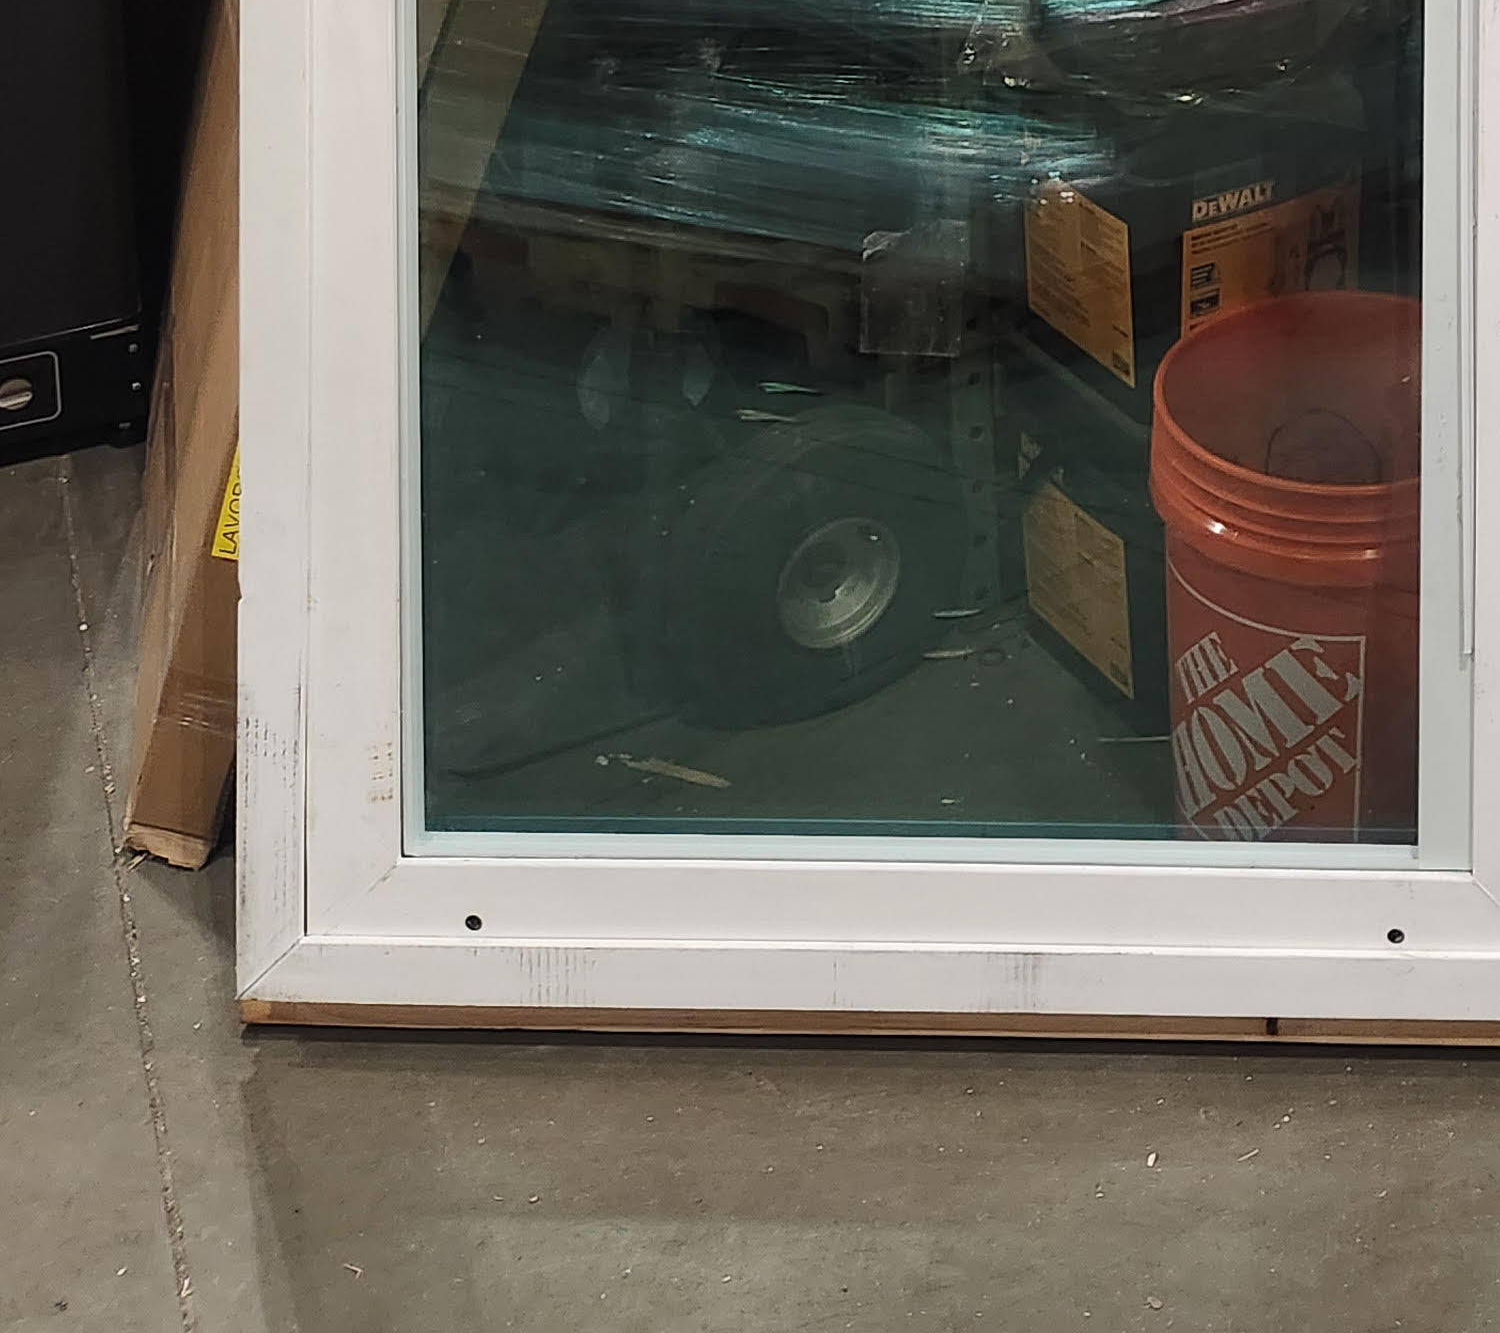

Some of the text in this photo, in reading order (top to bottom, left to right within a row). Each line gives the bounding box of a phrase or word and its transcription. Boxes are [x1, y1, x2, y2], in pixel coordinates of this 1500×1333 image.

[1175, 631, 1240, 705] THE
[1172, 637, 1363, 820] HOME
[1213, 726, 1358, 841] DEPOT
